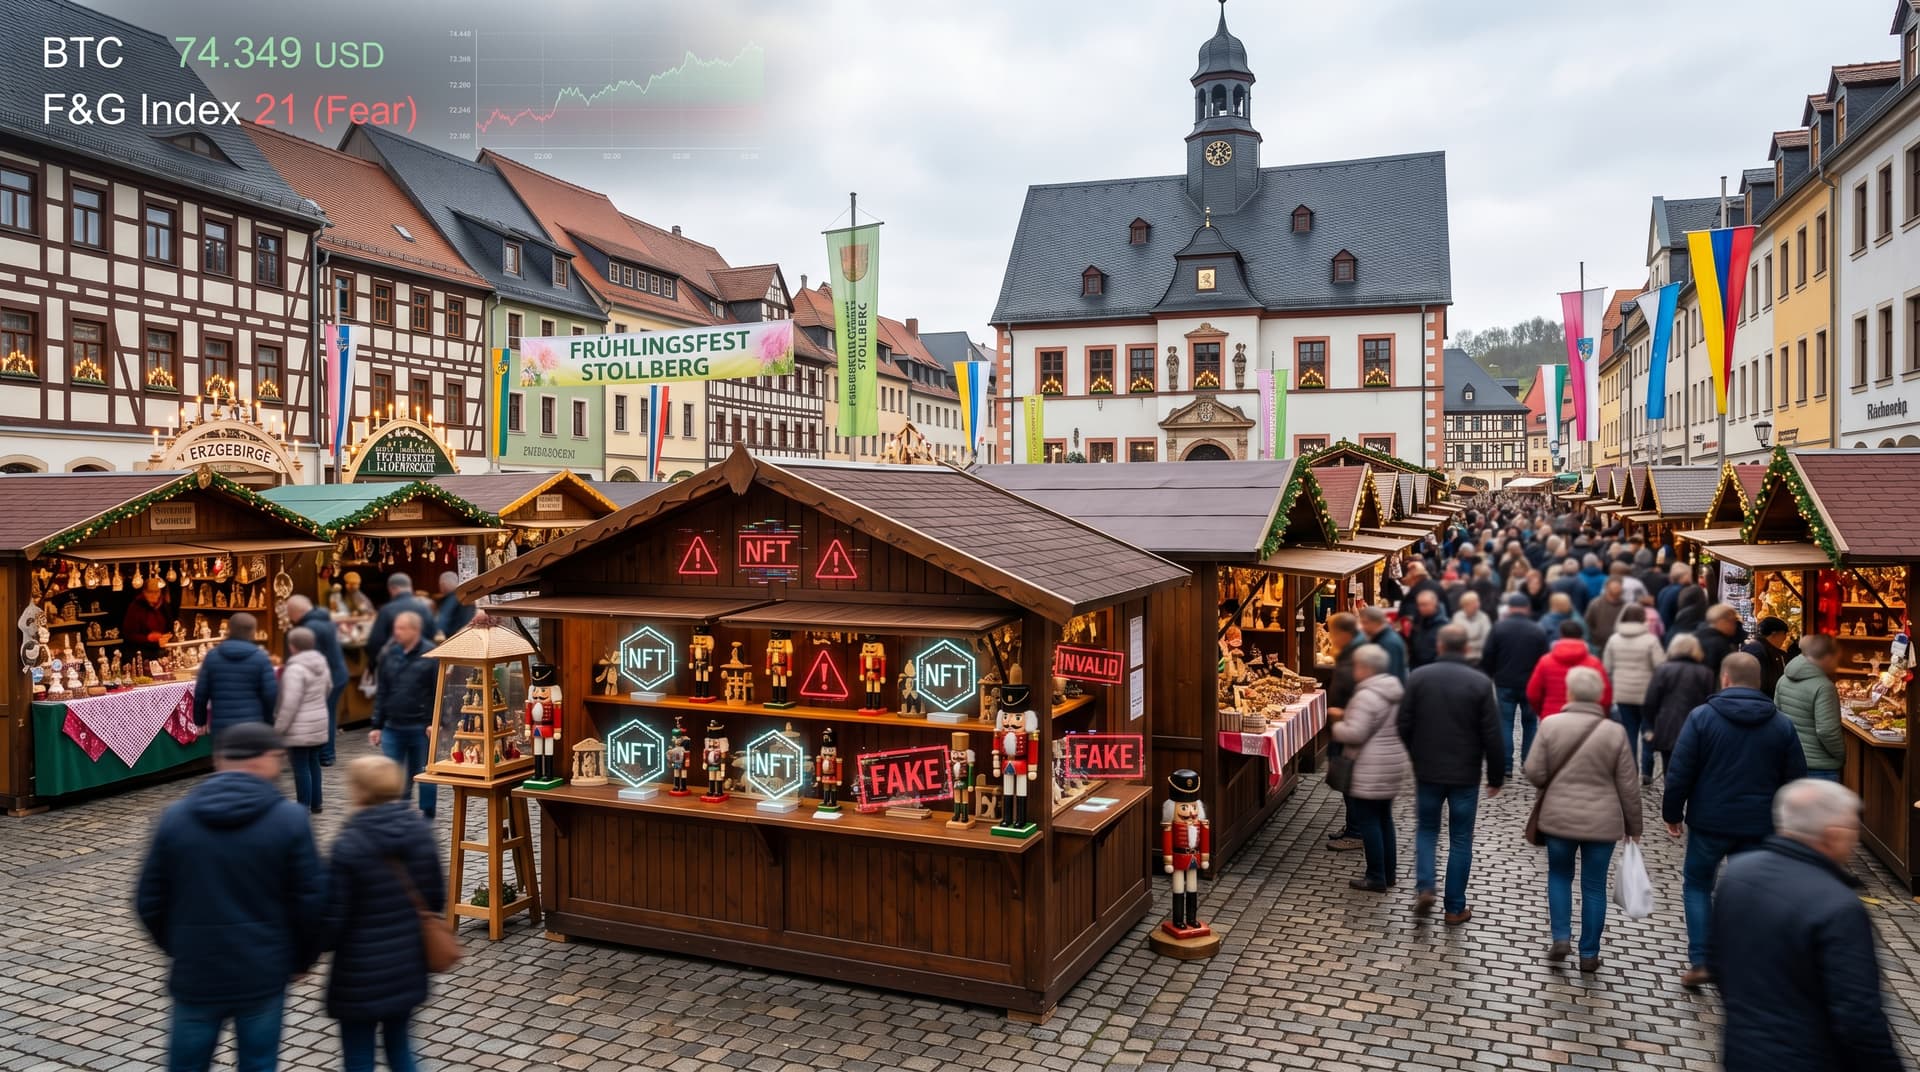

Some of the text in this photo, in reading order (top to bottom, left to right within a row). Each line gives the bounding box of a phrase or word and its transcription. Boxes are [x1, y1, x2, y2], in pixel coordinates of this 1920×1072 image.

[570, 330, 751, 359] FRÜHLINGSFEST
[581, 357, 709, 381] STOLLBERG
[190, 443, 272, 463] ERZGEBIRGE
[746, 540, 791, 563] NFT
[629, 648, 666, 671] NFT
[1059, 652, 1119, 677] INVALID
[925, 663, 966, 688] NFT
[616, 741, 656, 766] NFT
[756, 753, 795, 778] NFT
[1074, 744, 1134, 769] FAKE
[870, 758, 942, 796] FAKE
